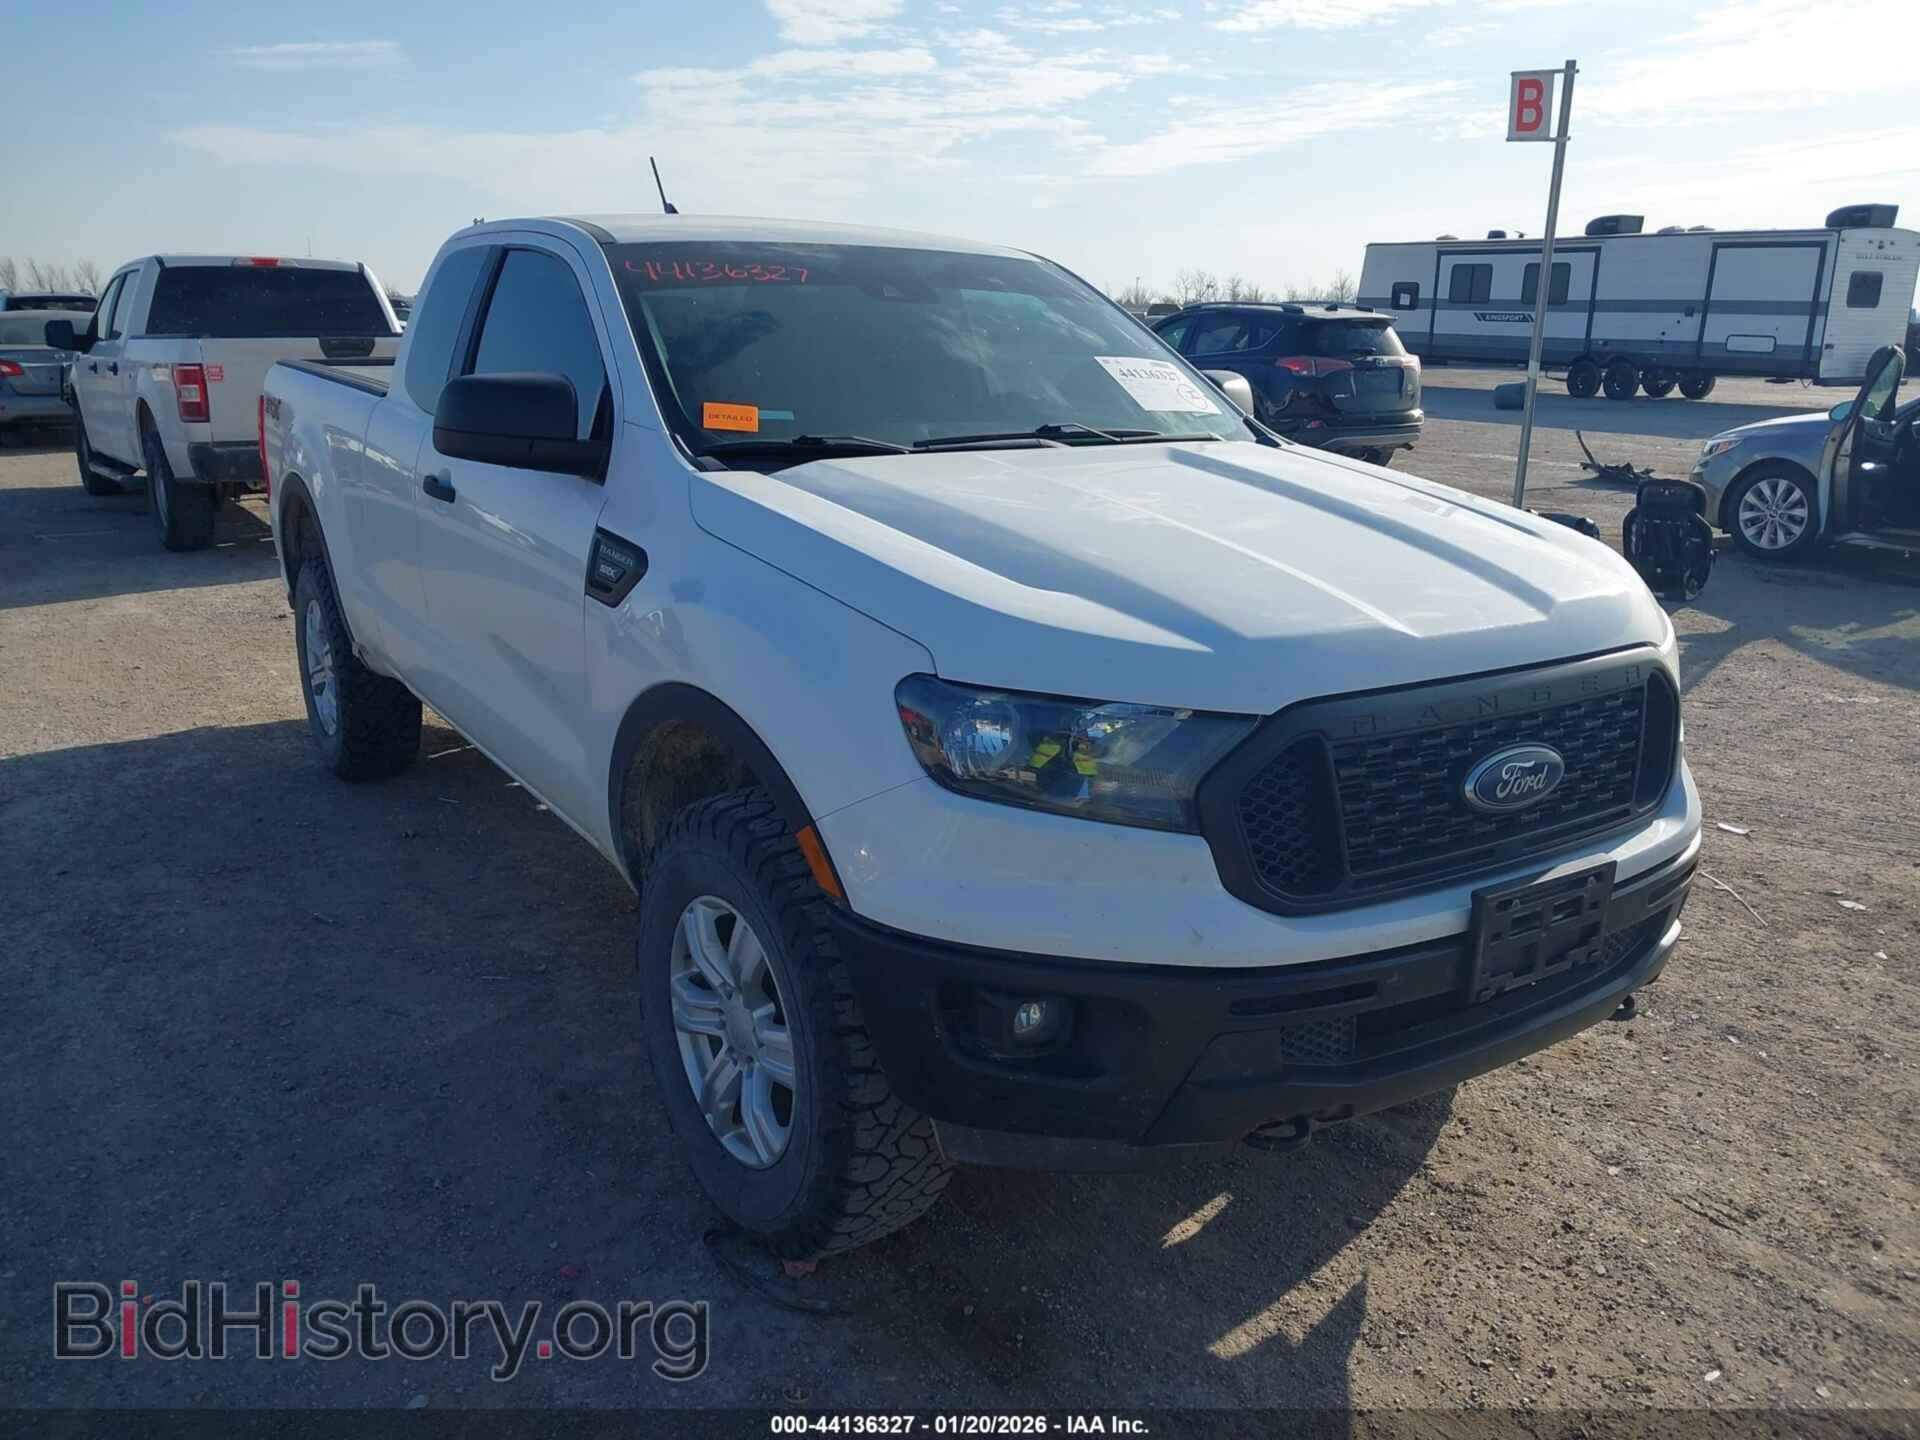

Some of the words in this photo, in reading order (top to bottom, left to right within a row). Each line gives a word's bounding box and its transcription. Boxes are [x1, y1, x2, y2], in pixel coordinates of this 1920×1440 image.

[1516, 79, 1544, 131] B
[625, 259, 808, 283] 44136327
[1496, 760, 1549, 800] Ford
